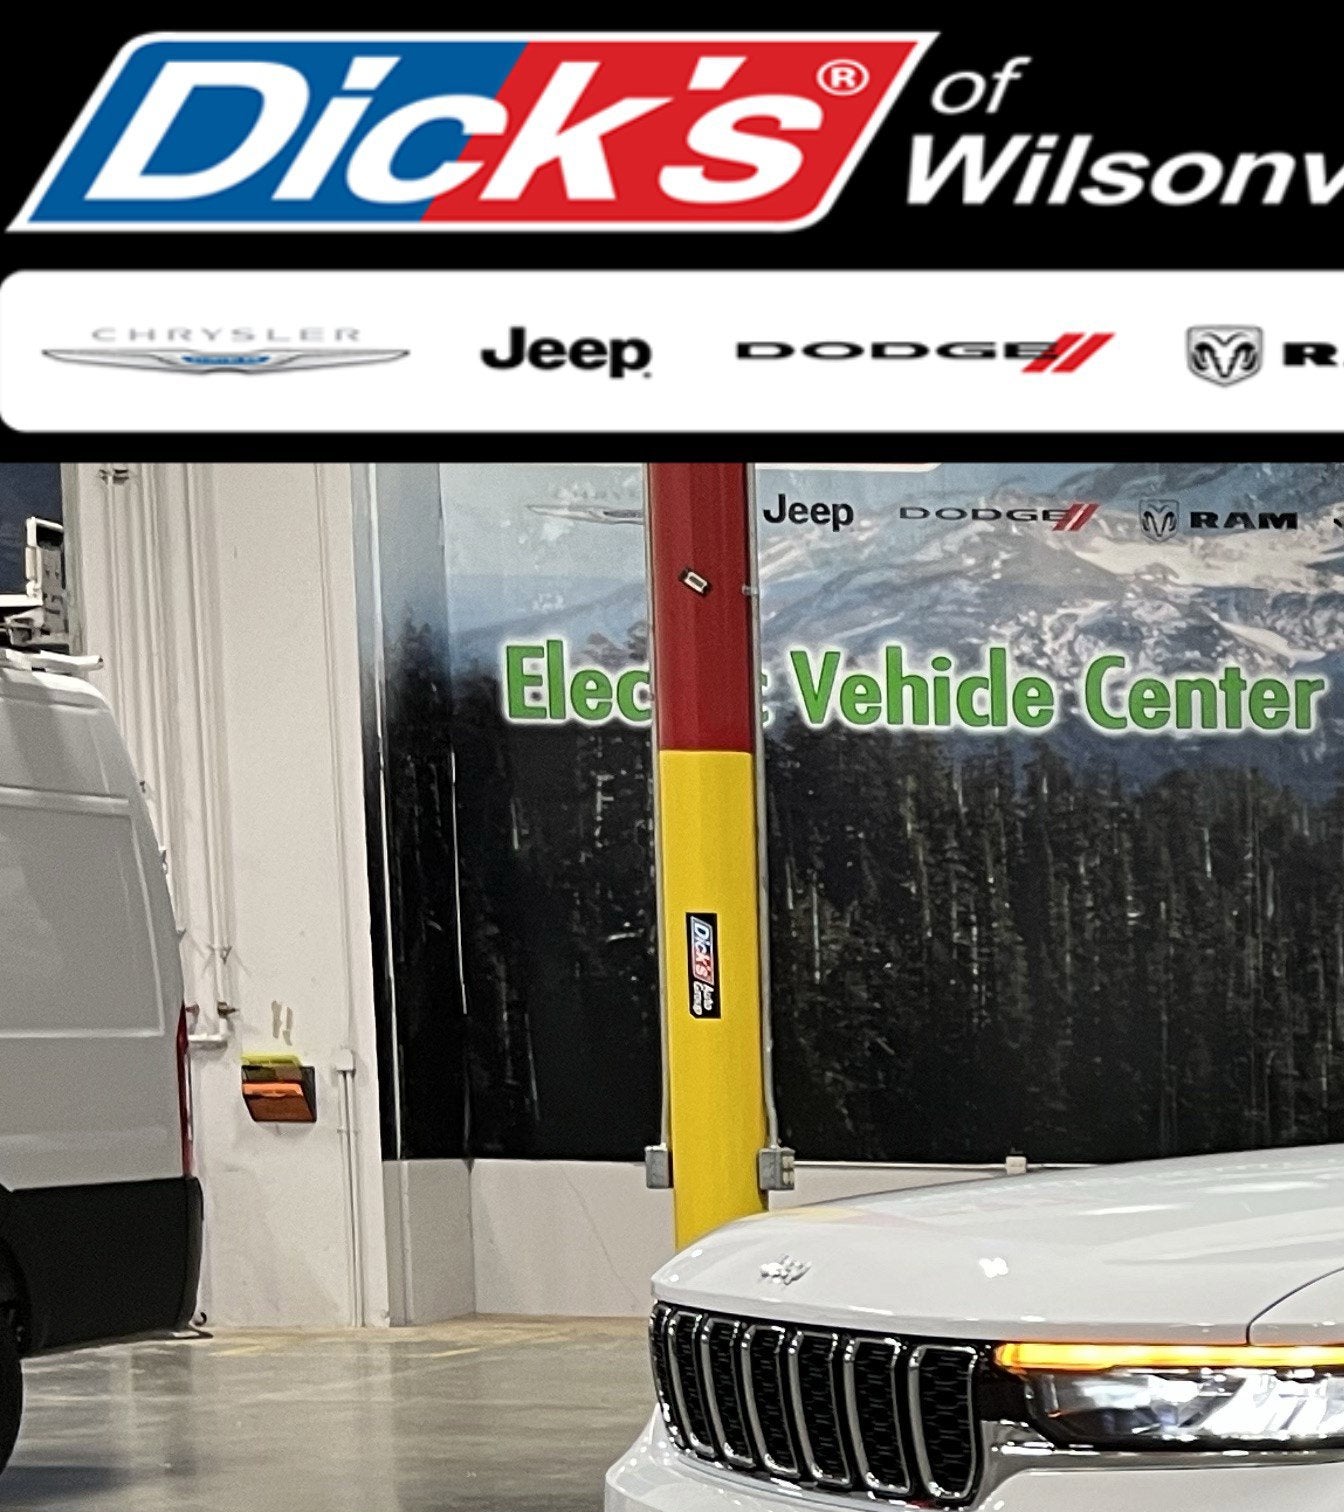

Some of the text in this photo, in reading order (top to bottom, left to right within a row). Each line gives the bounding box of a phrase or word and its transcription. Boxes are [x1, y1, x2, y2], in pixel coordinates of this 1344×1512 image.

[763, 493, 854, 533] Jeep
[899, 505, 1071, 522] DODGE
[1190, 511, 1299, 531] RAM
[790, 646, 1053, 727] Vehicle
[1085, 655, 1325, 731] Center
